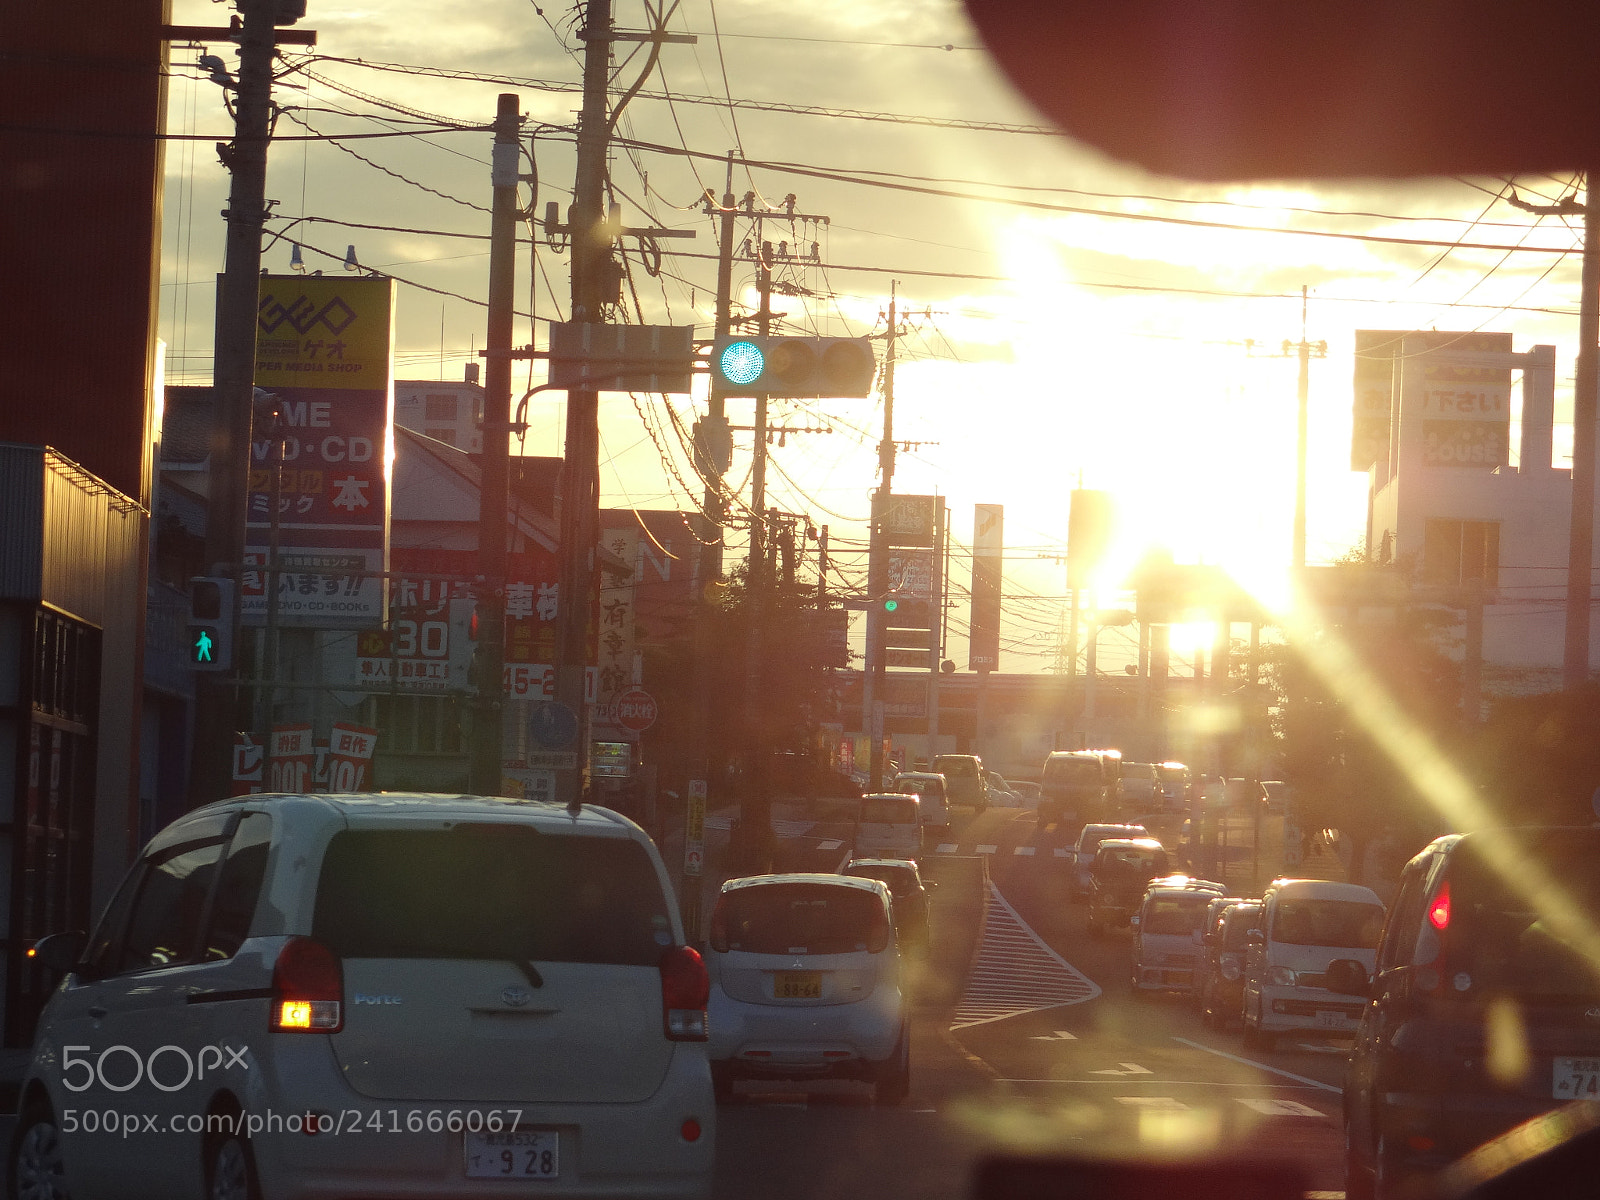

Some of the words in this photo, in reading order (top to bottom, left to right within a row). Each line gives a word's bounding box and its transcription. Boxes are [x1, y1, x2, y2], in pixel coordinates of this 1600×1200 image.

[303, 339, 348, 360] ゲオ
[285, 362, 324, 372] MEDIA
[327, 362, 364, 373] SHOP
[331, 475, 370, 512] 本
[620, 703, 655, 719] 消火栓
